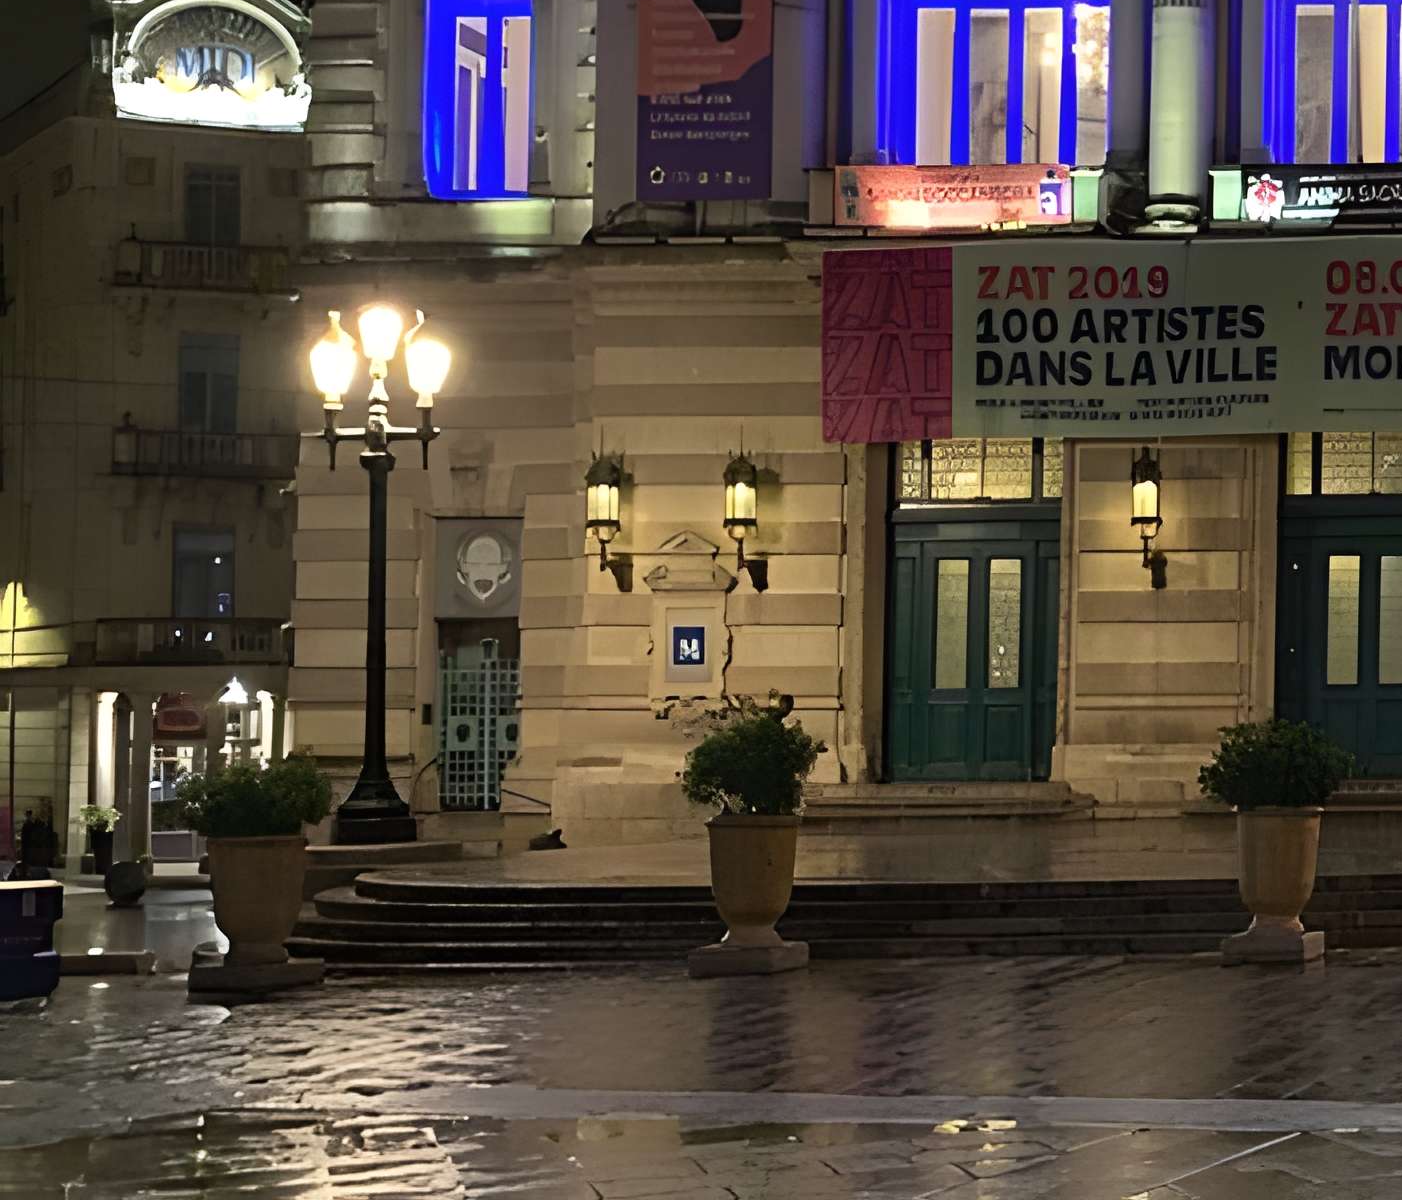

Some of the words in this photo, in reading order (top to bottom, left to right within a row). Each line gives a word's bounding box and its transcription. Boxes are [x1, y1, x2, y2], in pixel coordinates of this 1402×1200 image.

[976, 265, 1056, 300] ZAT
[1068, 265, 1169, 300] 2019
[976, 308, 1058, 344] 100
[1070, 304, 1265, 344] ARTISTES
[1325, 302, 1402, 336] ZAT
[976, 350, 1093, 386] DANS
[1105, 350, 1157, 386] LA
[1166, 346, 1277, 384] VILLE
